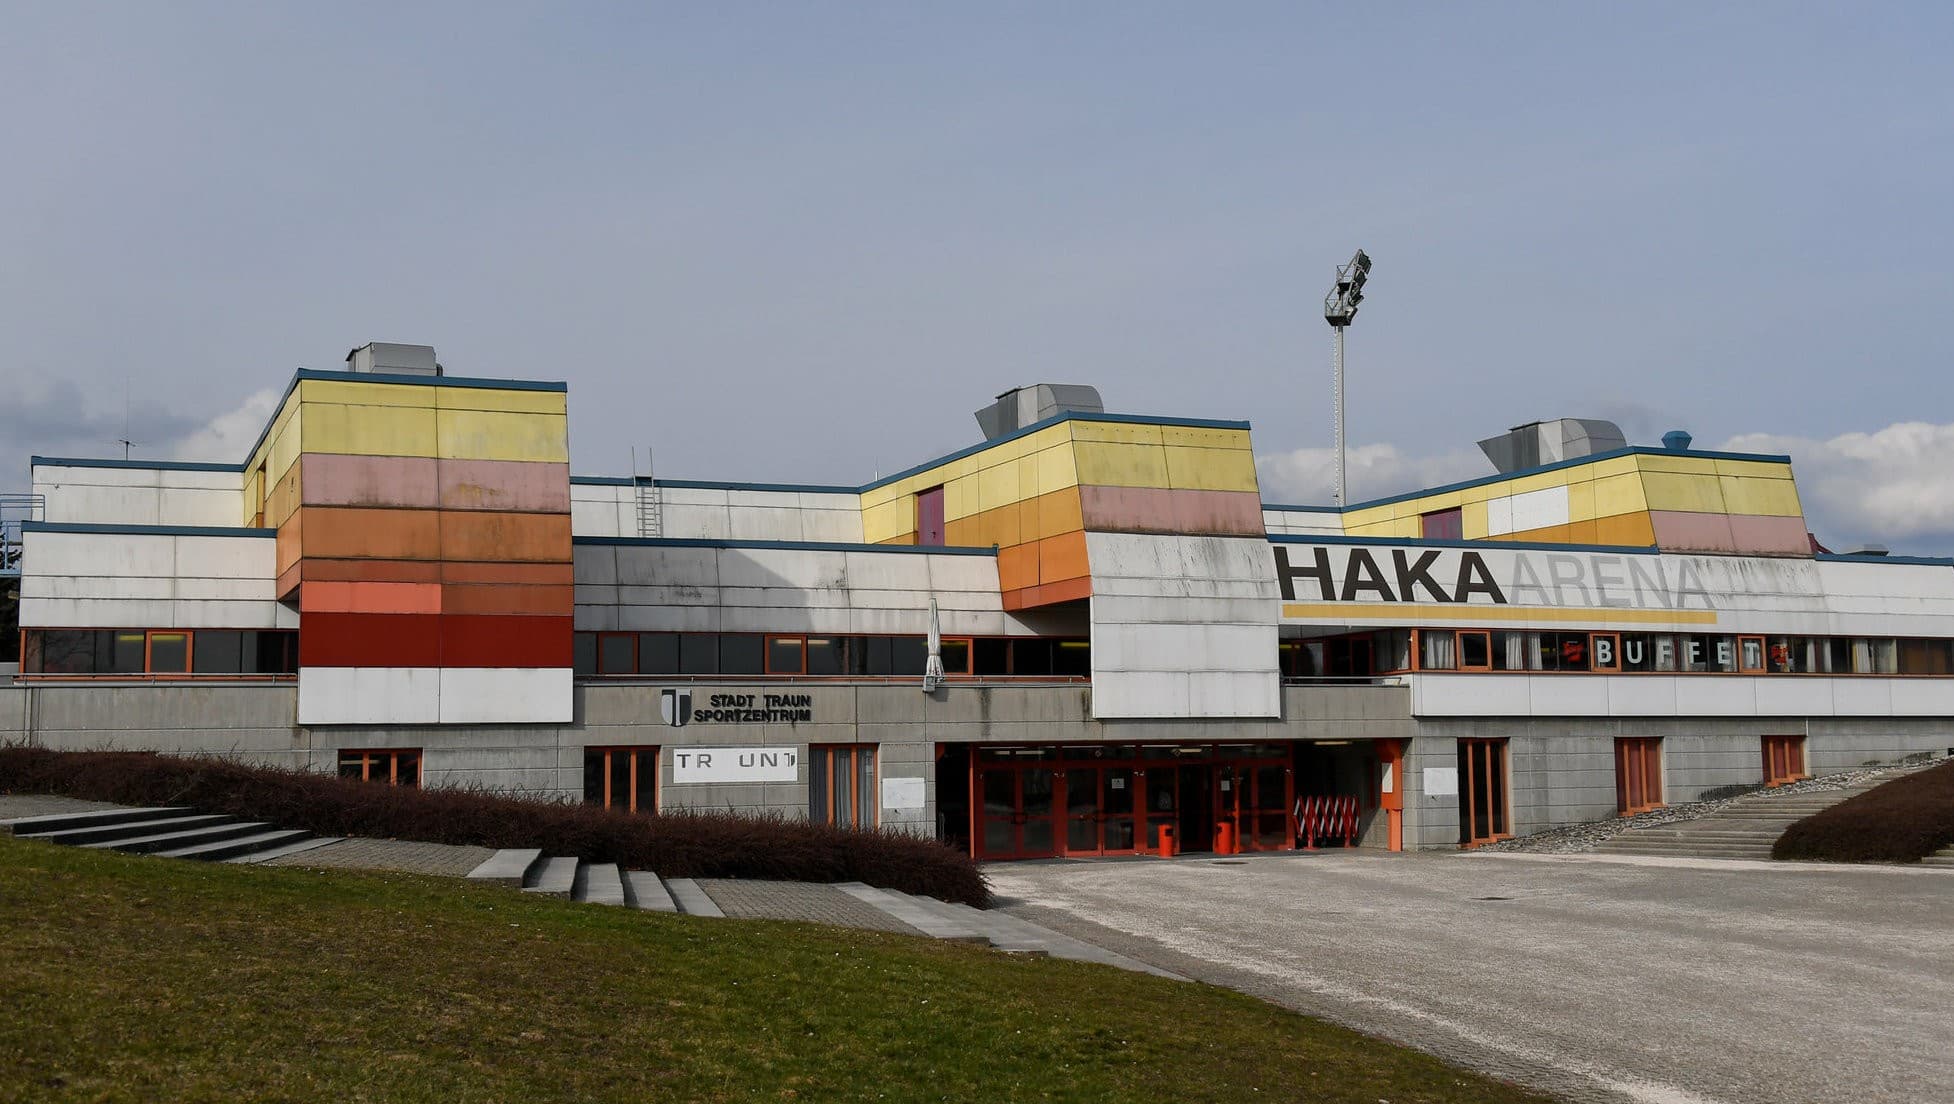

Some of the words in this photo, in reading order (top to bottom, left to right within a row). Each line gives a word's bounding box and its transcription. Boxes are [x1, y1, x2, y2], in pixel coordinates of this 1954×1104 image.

[1273, 546, 1508, 604] HAKA
[1507, 552, 1717, 609] ARENA
[1597, 639, 1760, 665] BUFFET
[710, 694, 756, 708] STADT
[763, 694, 812, 709] TRAUN
[694, 709, 812, 722] SPORTZENTRUM
